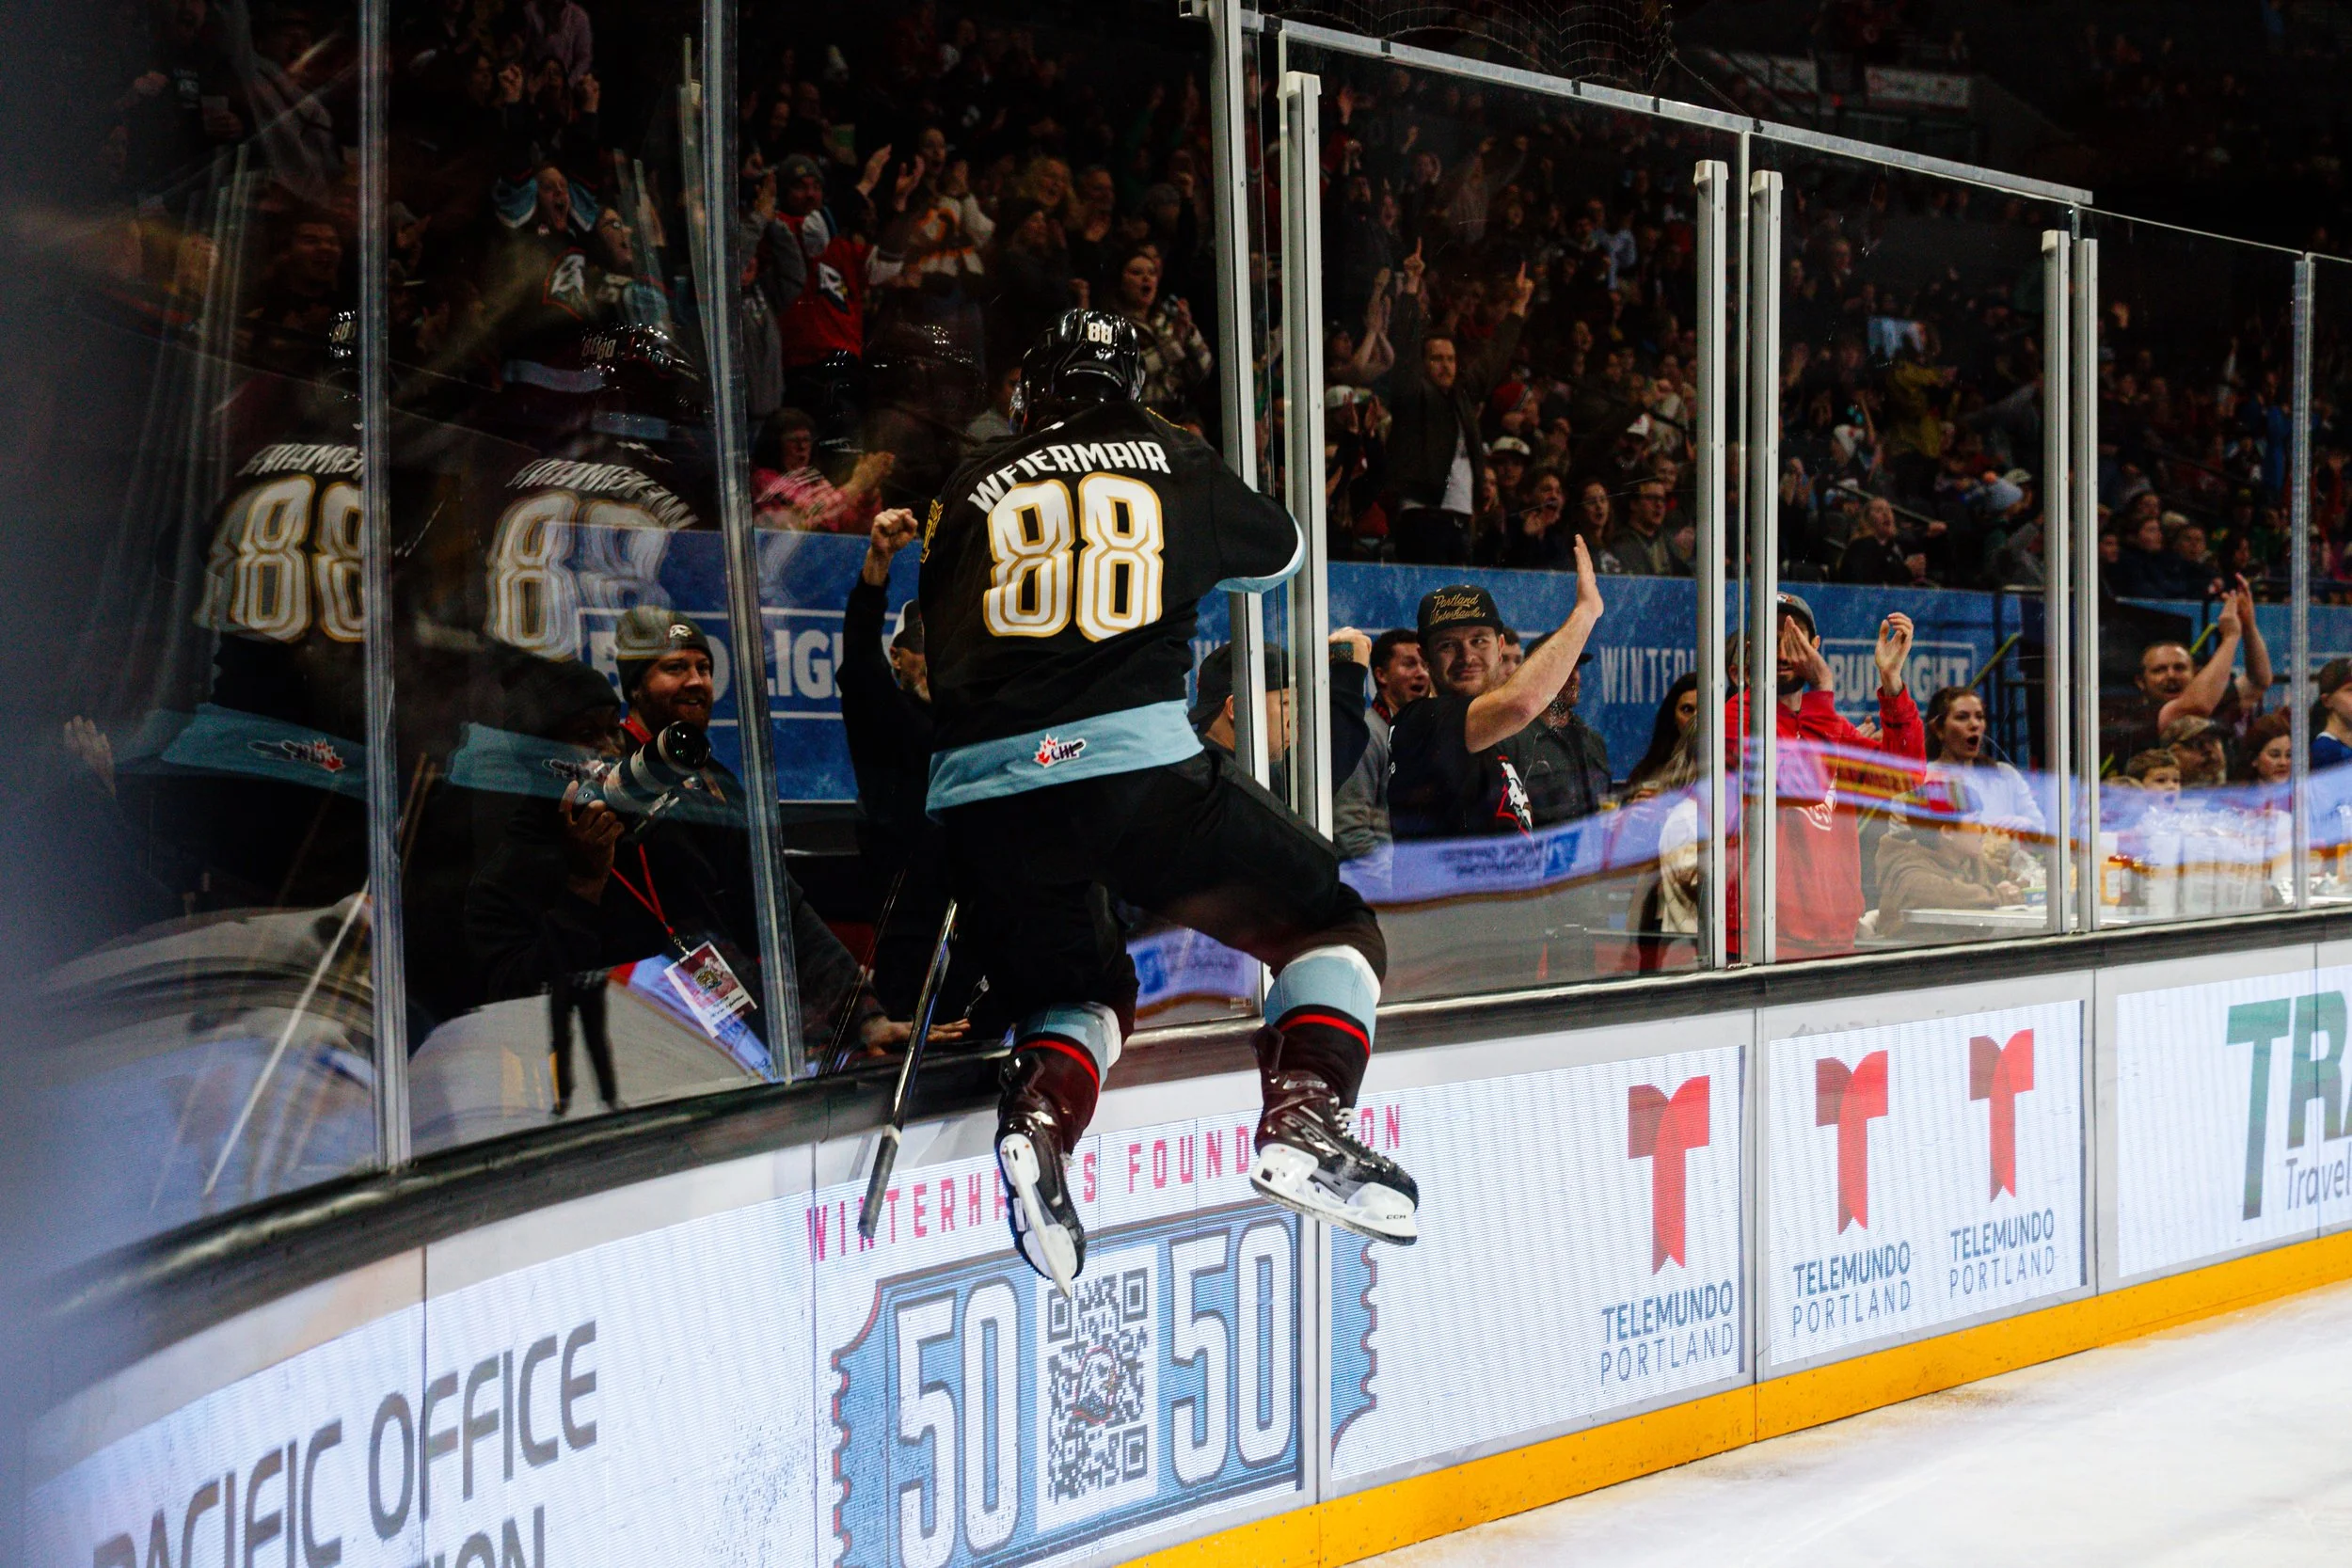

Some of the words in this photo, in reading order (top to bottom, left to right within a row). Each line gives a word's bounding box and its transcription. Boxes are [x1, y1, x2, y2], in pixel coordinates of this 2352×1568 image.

[1088, 323, 1112, 344] 88
[983, 471, 1164, 642] 88
[1431, 594, 1481, 612] Portland
[2226, 990, 2352, 1221] TR
[1950, 1208, 2055, 1261] TELEMUNDO
[1793, 1241, 1911, 1297] TELEMUNDO
[1949, 1246, 2055, 1299] PORTLAND
[1602, 1280, 1733, 1344] TELEMUNDO
[1793, 1280, 1911, 1338] PORTLAND
[1601, 1323, 1733, 1386] PORTLAND
[895, 1275, 1022, 1568] 50
[1168, 1217, 1298, 1488] 50
[369, 1320, 597, 1541] OFFICE
